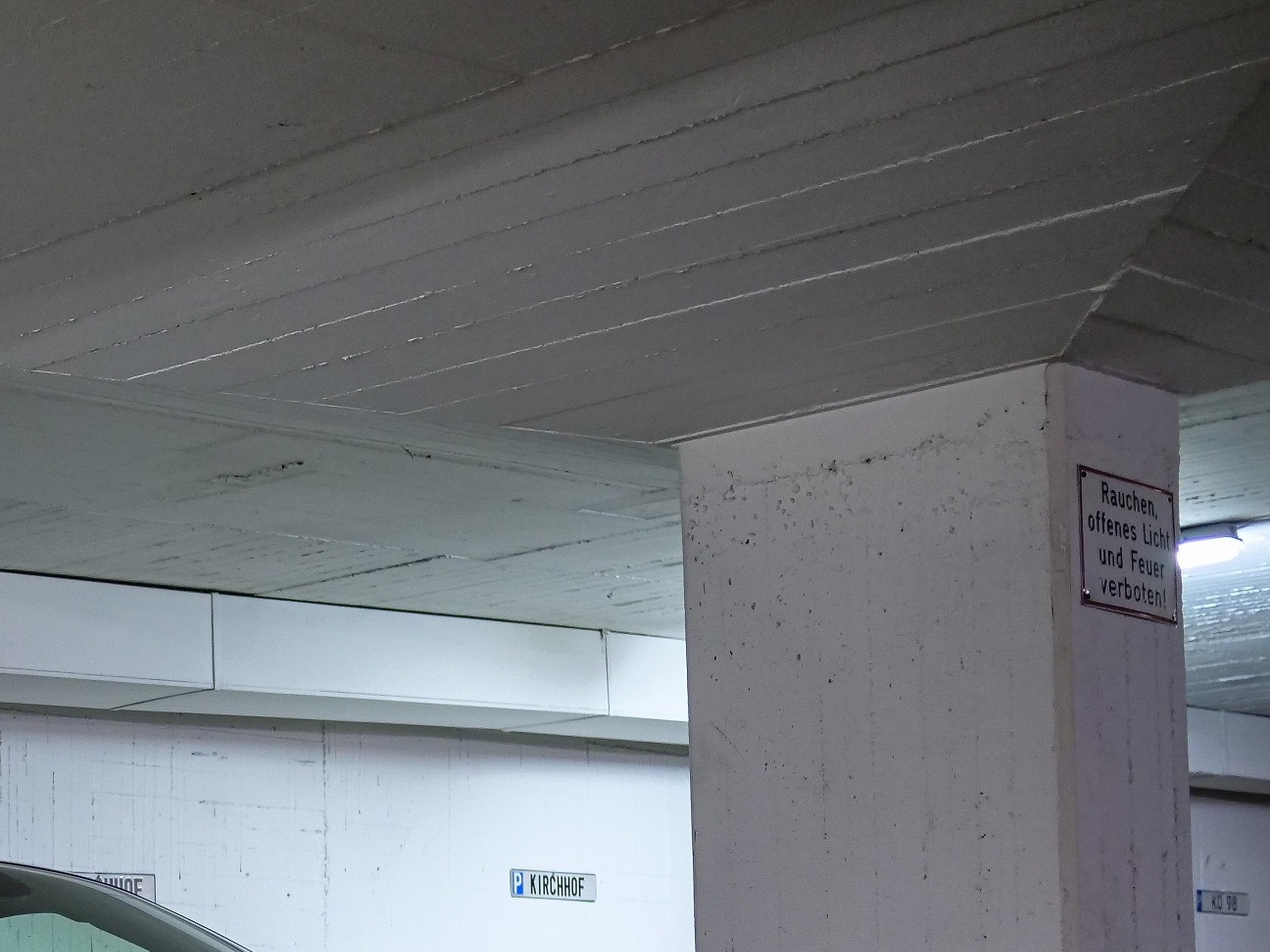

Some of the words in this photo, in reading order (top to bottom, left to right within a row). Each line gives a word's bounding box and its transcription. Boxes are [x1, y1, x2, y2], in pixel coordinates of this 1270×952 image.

[1101, 481, 1158, 520] Rauchen,
[1088, 511, 1137, 541] offenes
[1143, 522, 1170, 550] Licht
[1099, 547, 1124, 570] und
[1131, 550, 1164, 579] Feuer
[1099, 577, 1166, 608] verboten!
[530, 873, 585, 897] KIRCHHOF
